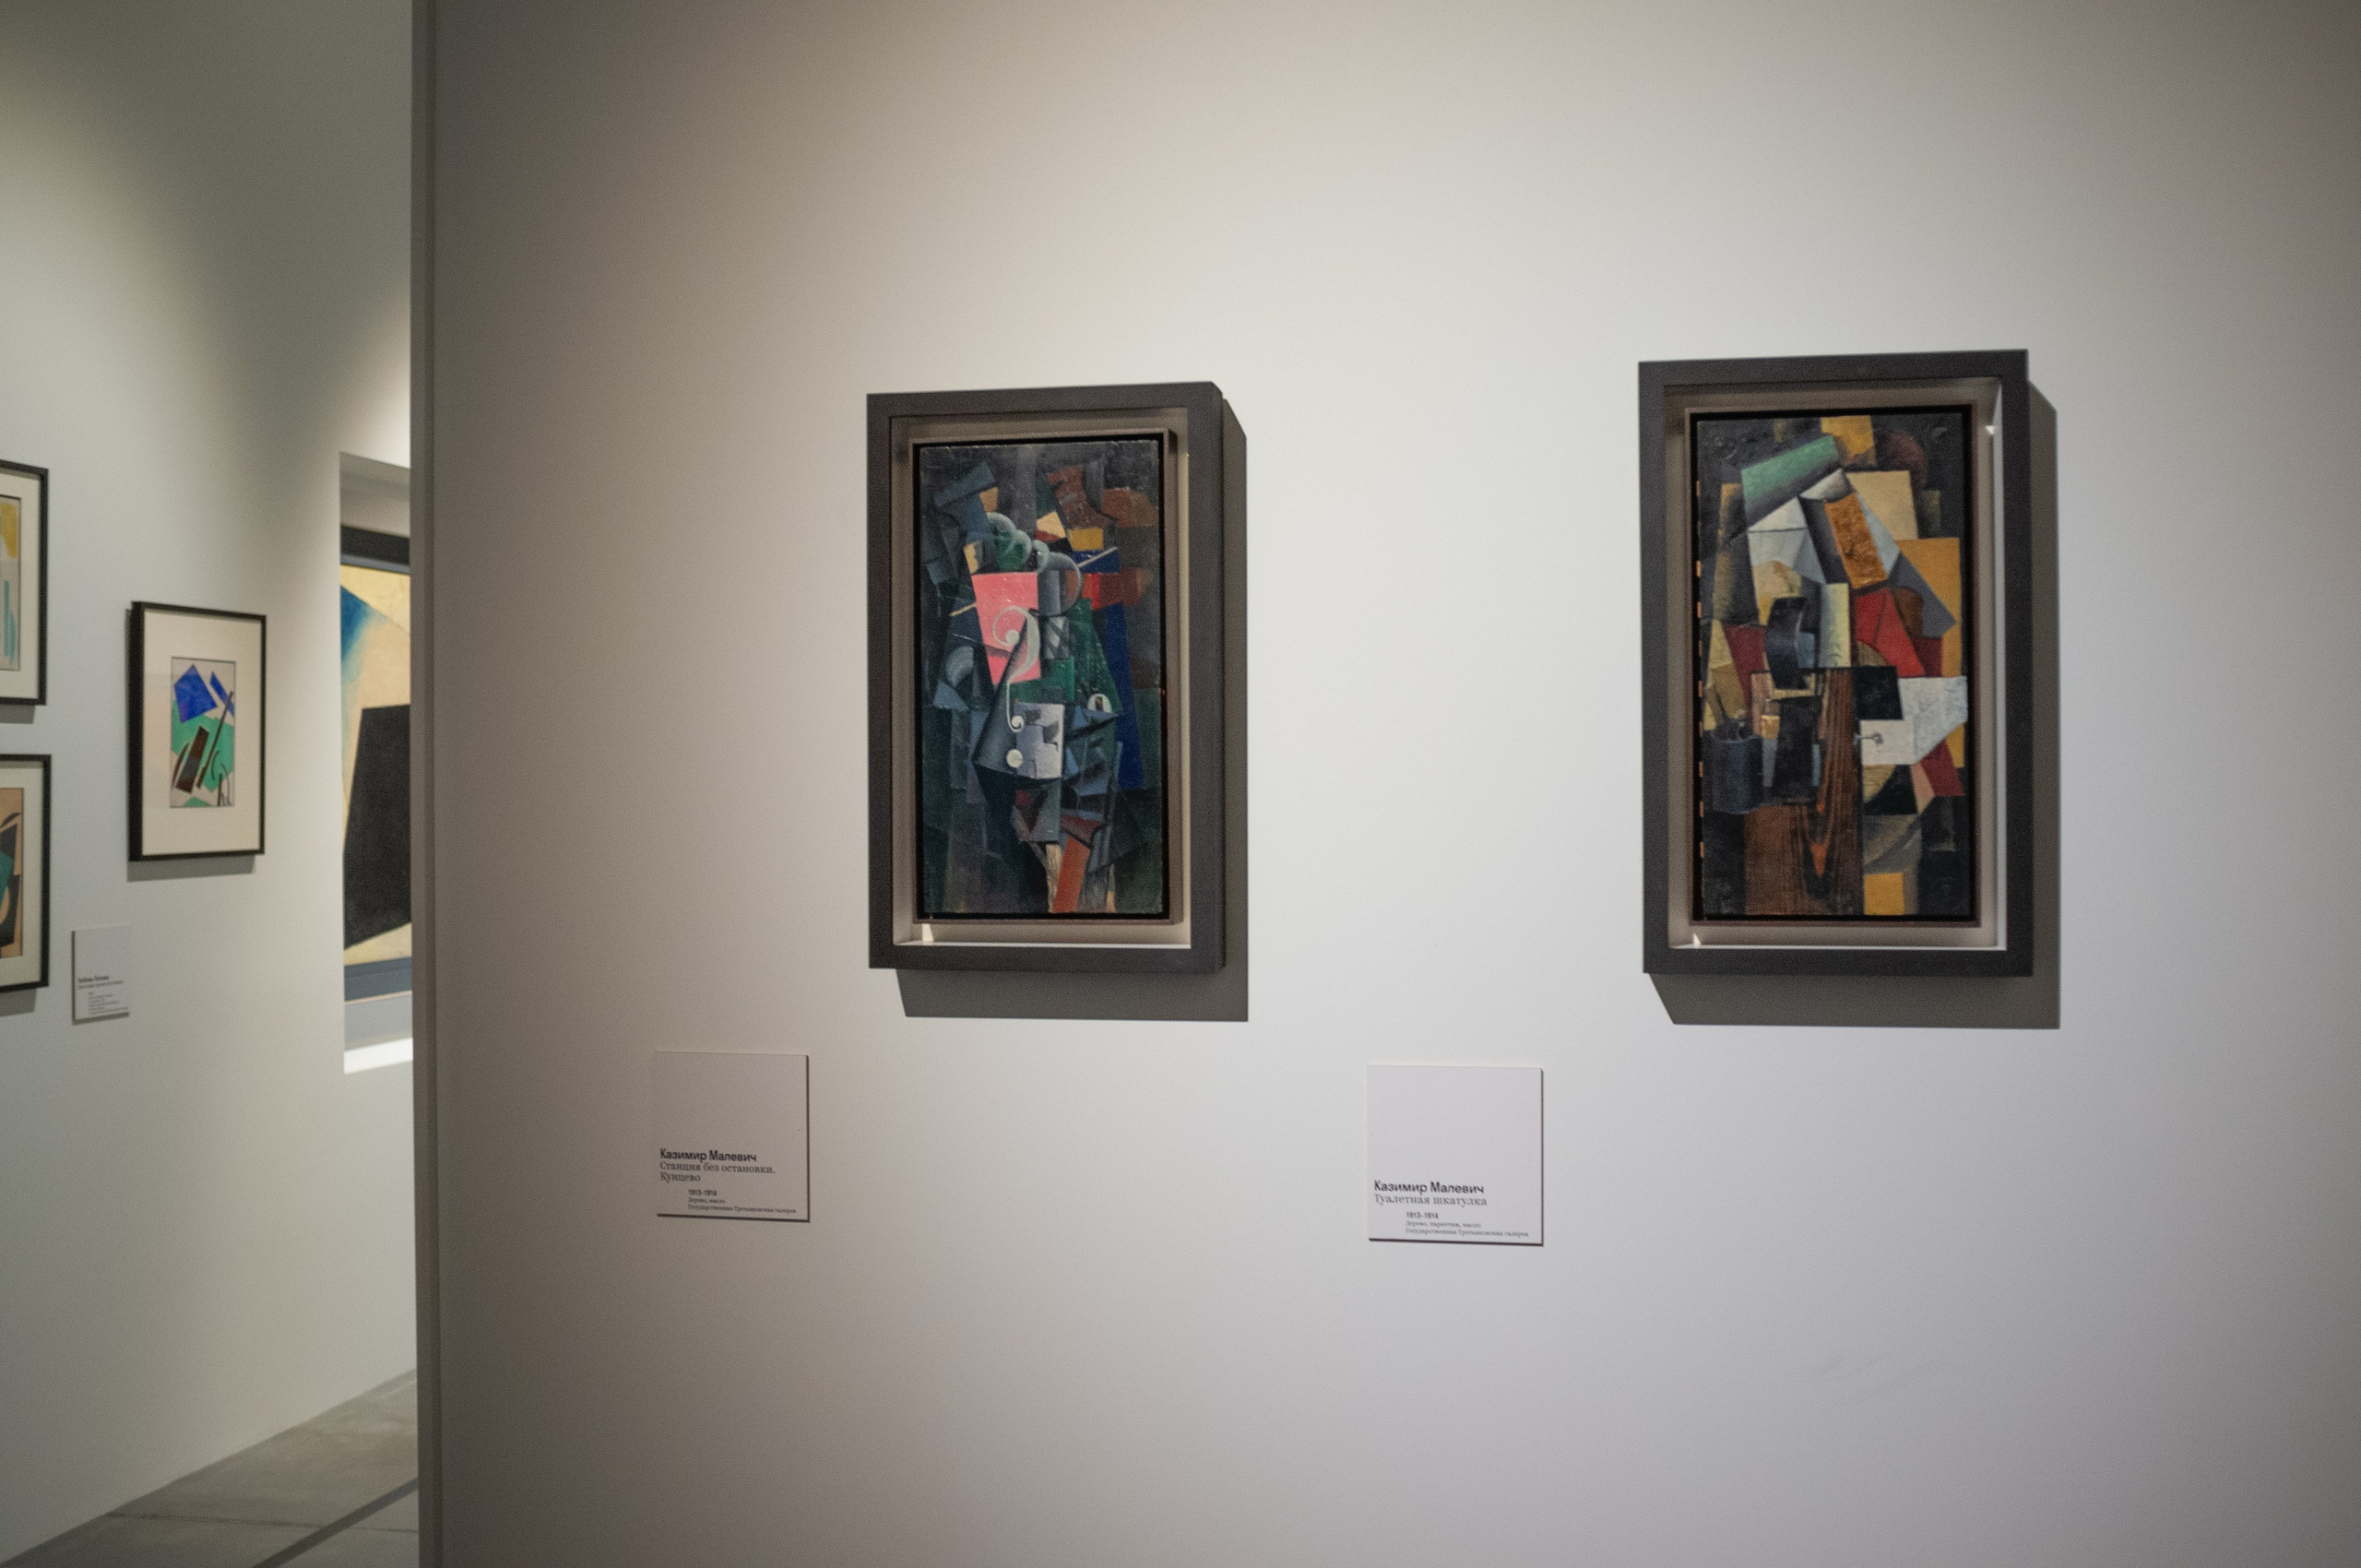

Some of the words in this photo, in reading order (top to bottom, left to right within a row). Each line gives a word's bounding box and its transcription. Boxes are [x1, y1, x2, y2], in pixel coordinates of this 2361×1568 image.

[659, 1147, 707, 1163] Казимир
[709, 1149, 757, 1162] Малевич
[659, 1161, 701, 1172] Станция
[703, 1162, 719, 1172] без
[659, 1172, 701, 1183] Кунцево
[1374, 1180, 1428, 1195] Казимир
[1430, 1182, 1485, 1194] Малевич
[1374, 1194, 1430, 1206] Туалетная
[1433, 1196, 1488, 1208] шкатулка
